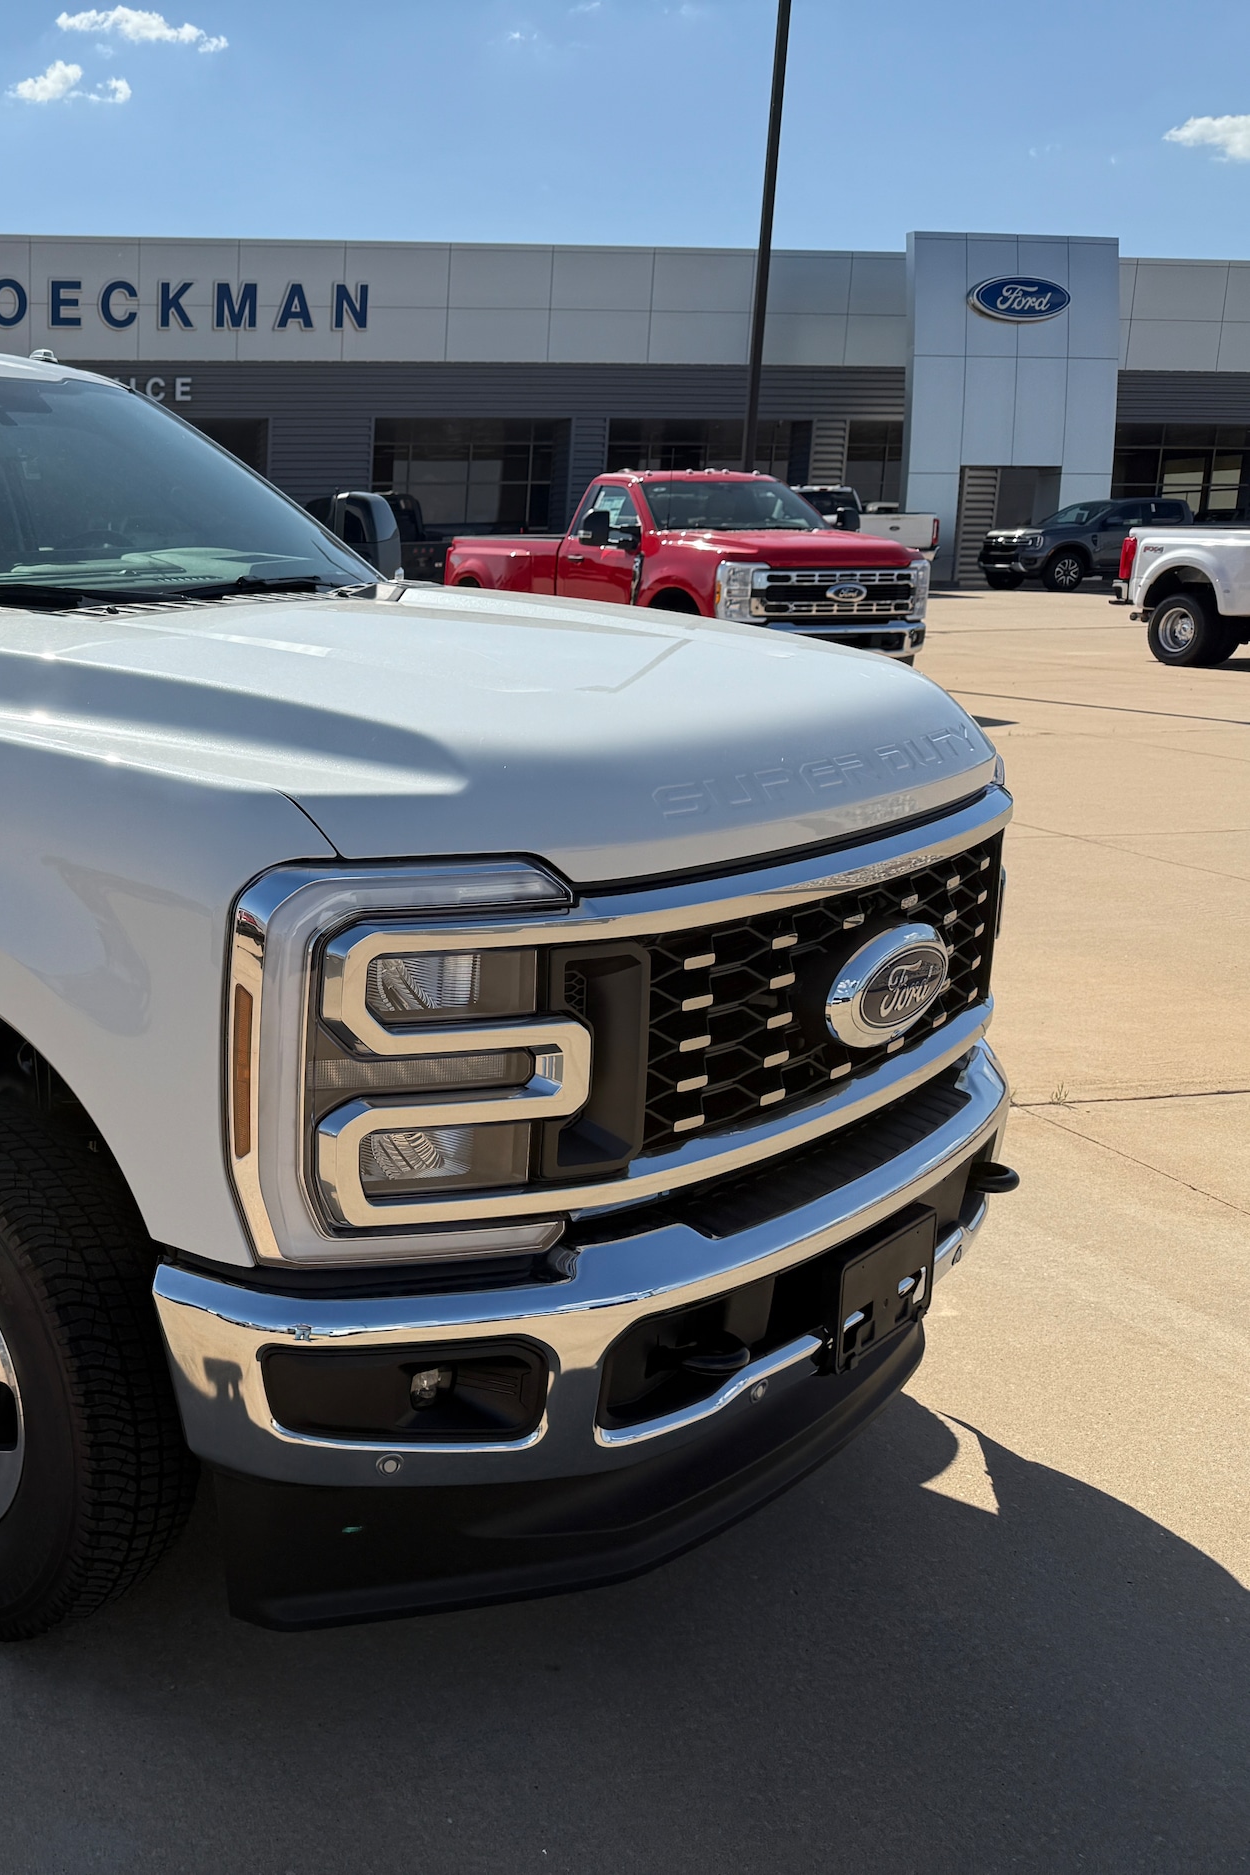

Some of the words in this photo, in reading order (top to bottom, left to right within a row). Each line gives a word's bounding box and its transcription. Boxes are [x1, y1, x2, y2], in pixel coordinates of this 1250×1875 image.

[996, 284, 1052, 311] Ford
[651, 753, 880, 821] SUPER
[876, 723, 976, 775] DUTY
[880, 958, 938, 1019] Ford
